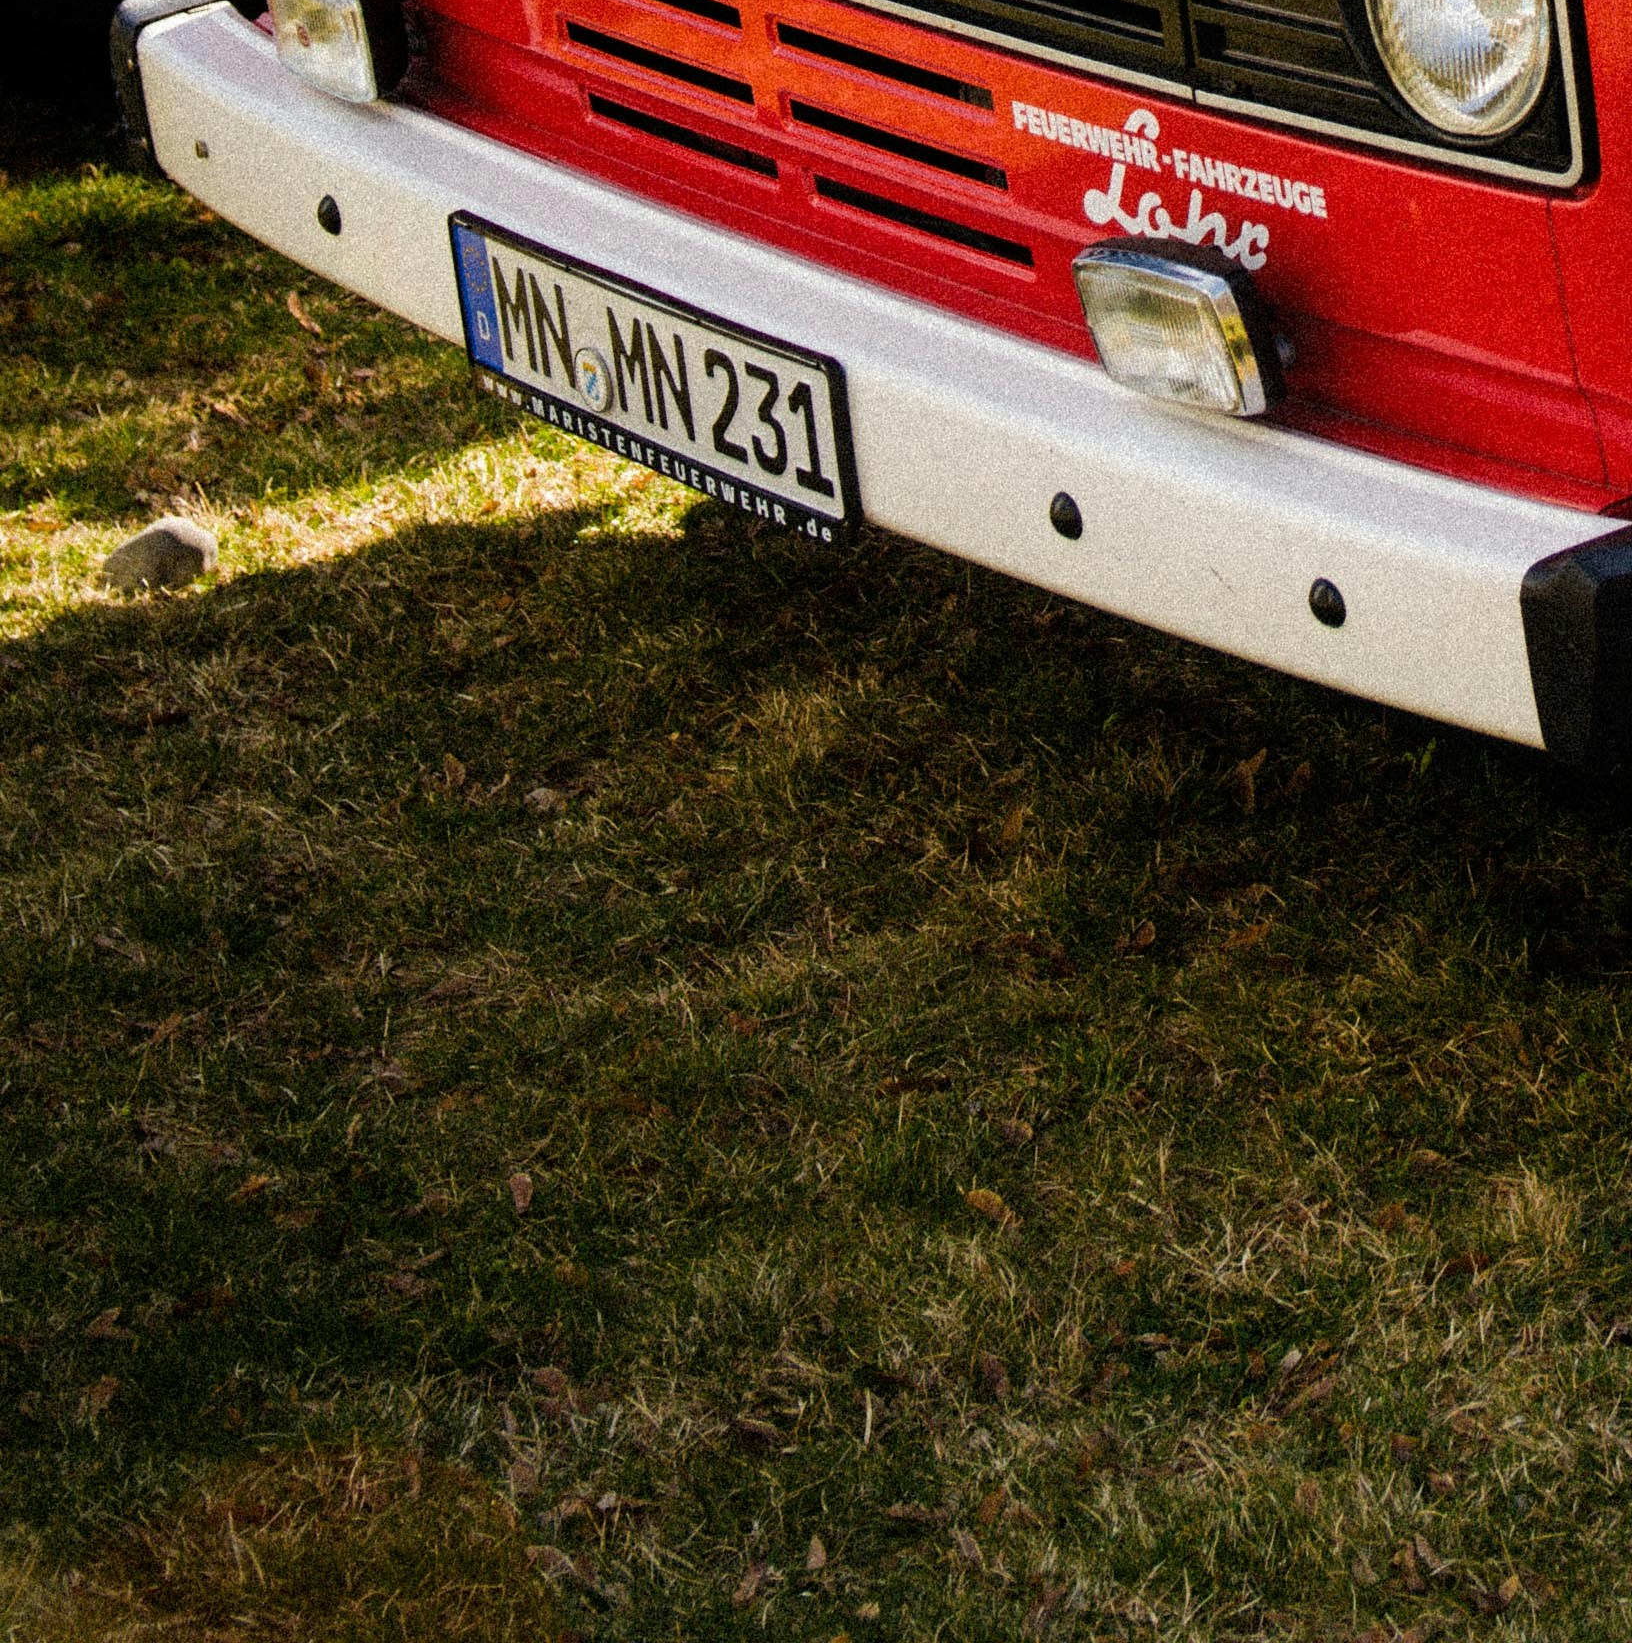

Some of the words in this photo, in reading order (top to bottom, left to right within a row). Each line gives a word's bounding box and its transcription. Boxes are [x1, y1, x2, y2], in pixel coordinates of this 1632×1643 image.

[476, 310, 492, 341] D
[492, 256, 577, 390] MN
[607, 306, 696, 443] MN
[704, 348, 835, 499] 231
